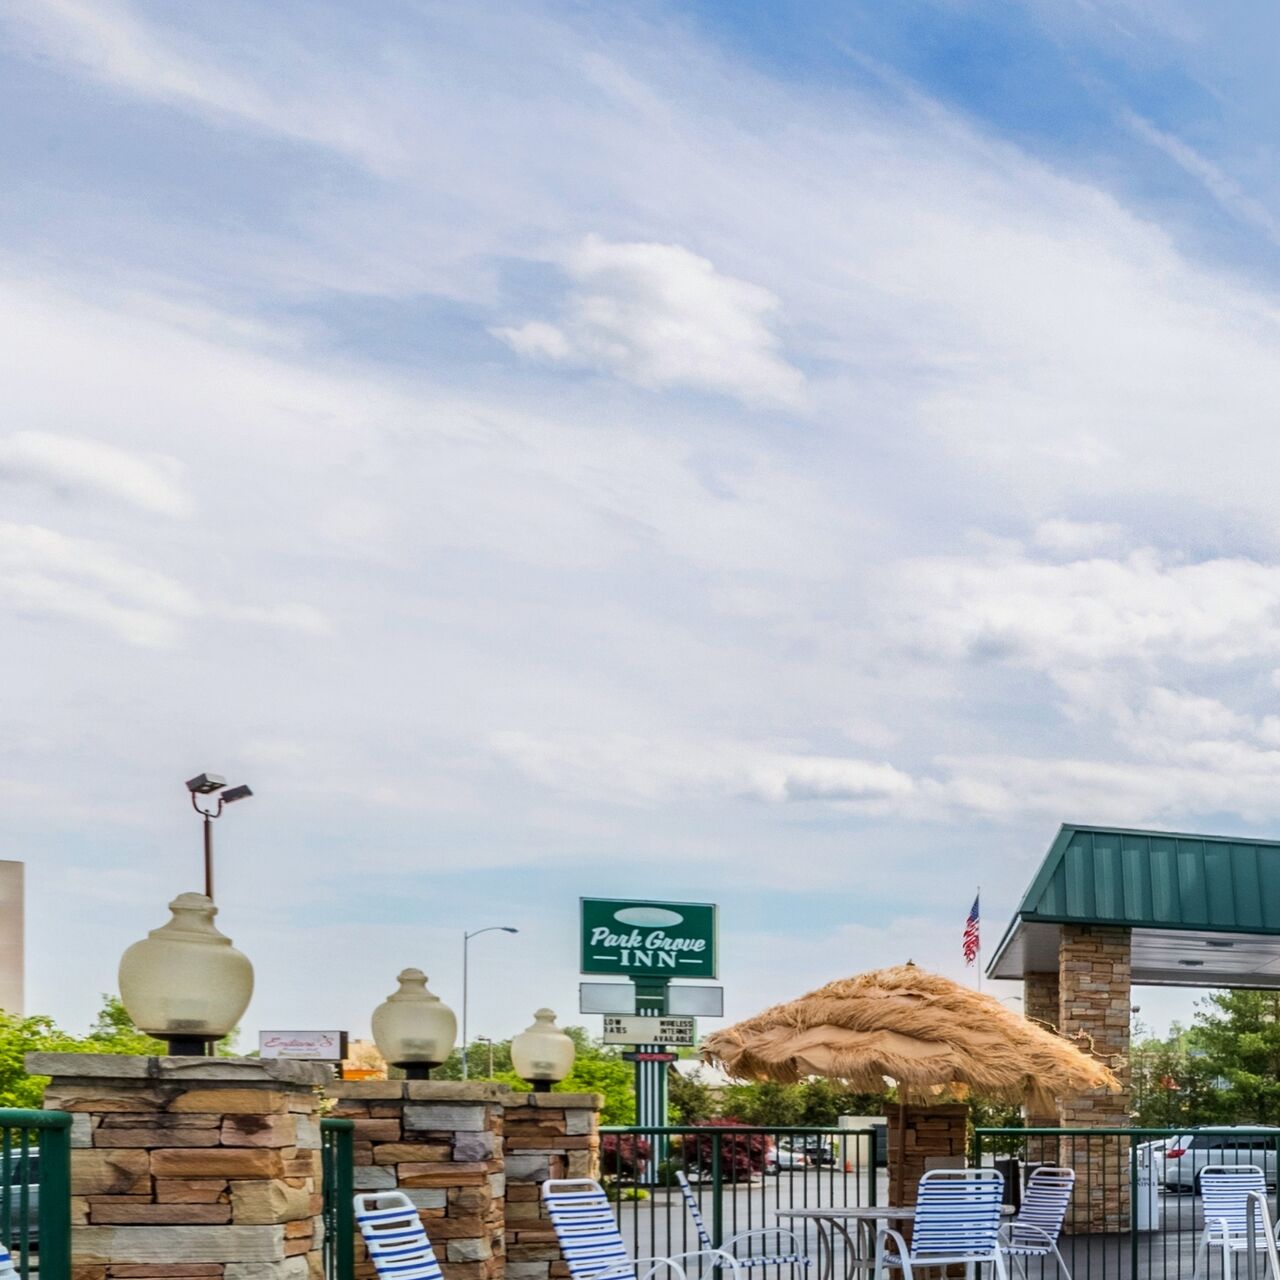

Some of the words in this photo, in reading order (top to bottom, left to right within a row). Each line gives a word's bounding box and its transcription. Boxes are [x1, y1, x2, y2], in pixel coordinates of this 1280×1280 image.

[590, 927, 642, 948] Park
[645, 930, 706, 952] Grove
[620, 950, 677, 968] INN
[604, 1018, 621, 1026] LOW
